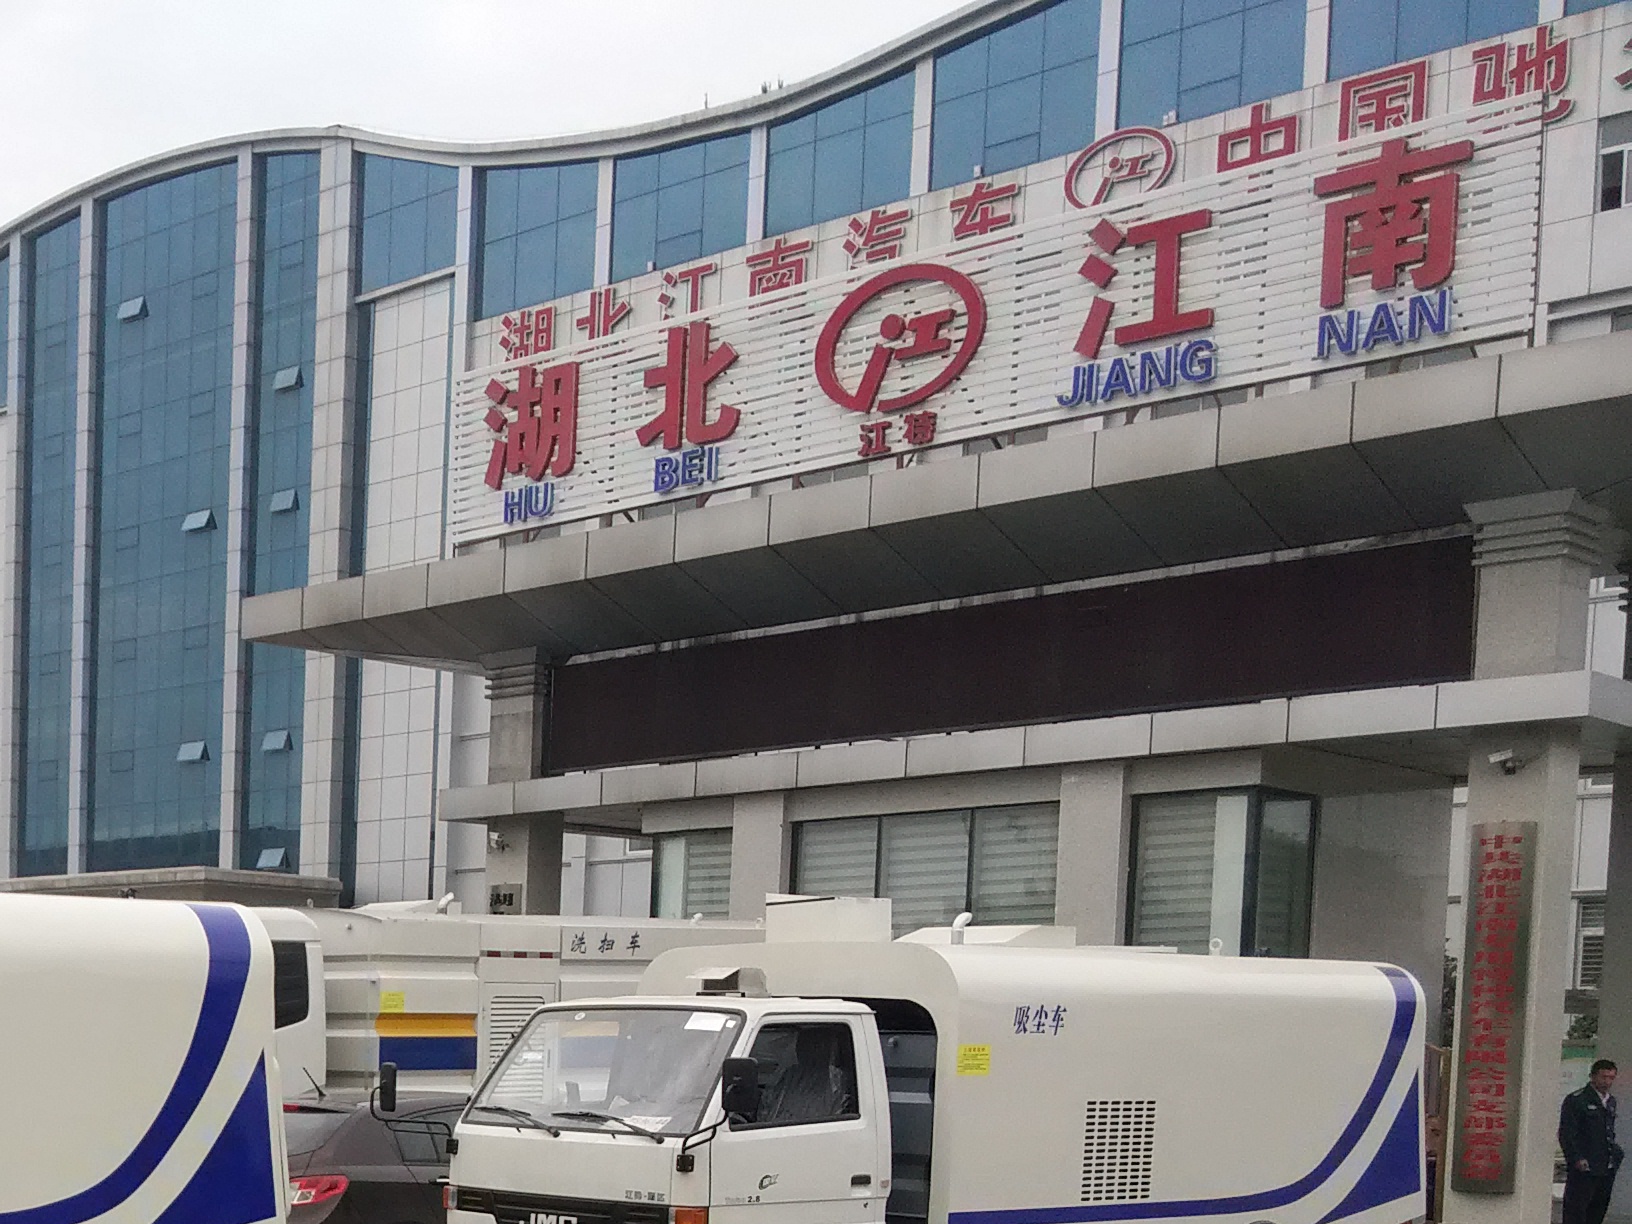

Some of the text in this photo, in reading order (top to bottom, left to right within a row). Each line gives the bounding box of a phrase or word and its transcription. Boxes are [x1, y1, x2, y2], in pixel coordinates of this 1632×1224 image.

[1216, 24, 1632, 178] 中国驰
[1072, 137, 1475, 360] 江南
[483, 321, 742, 491] 湖北
[503, 288, 1454, 525] HU BEI JIANG NAN
[570, 931, 641, 956] 洗扫车
[1013, 1004, 1067, 1036] 吸尘车
